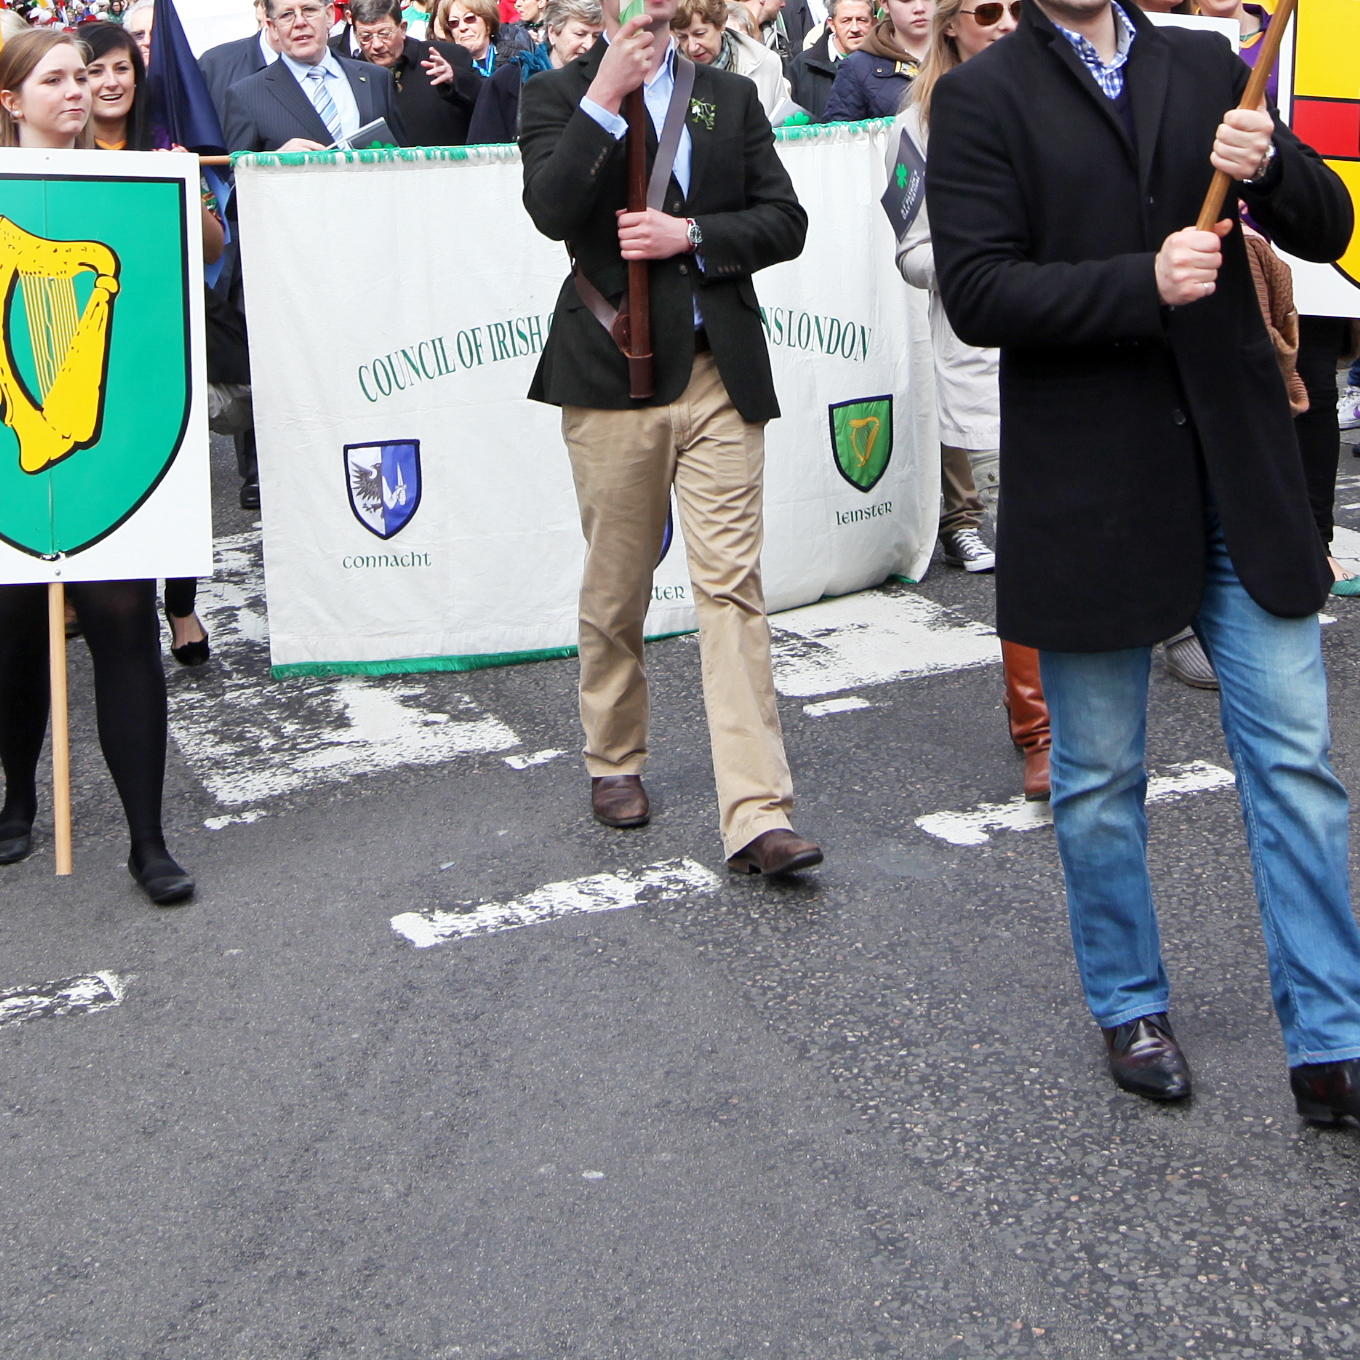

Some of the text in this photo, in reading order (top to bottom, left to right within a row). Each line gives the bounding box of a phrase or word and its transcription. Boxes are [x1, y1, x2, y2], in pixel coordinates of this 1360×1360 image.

[358, 336, 456, 403] COUNCIL
[457, 327, 485, 369] OF
[486, 315, 544, 362] IRISH
[787, 310, 872, 363] LONDON
[342, 551, 432, 569] connacht
